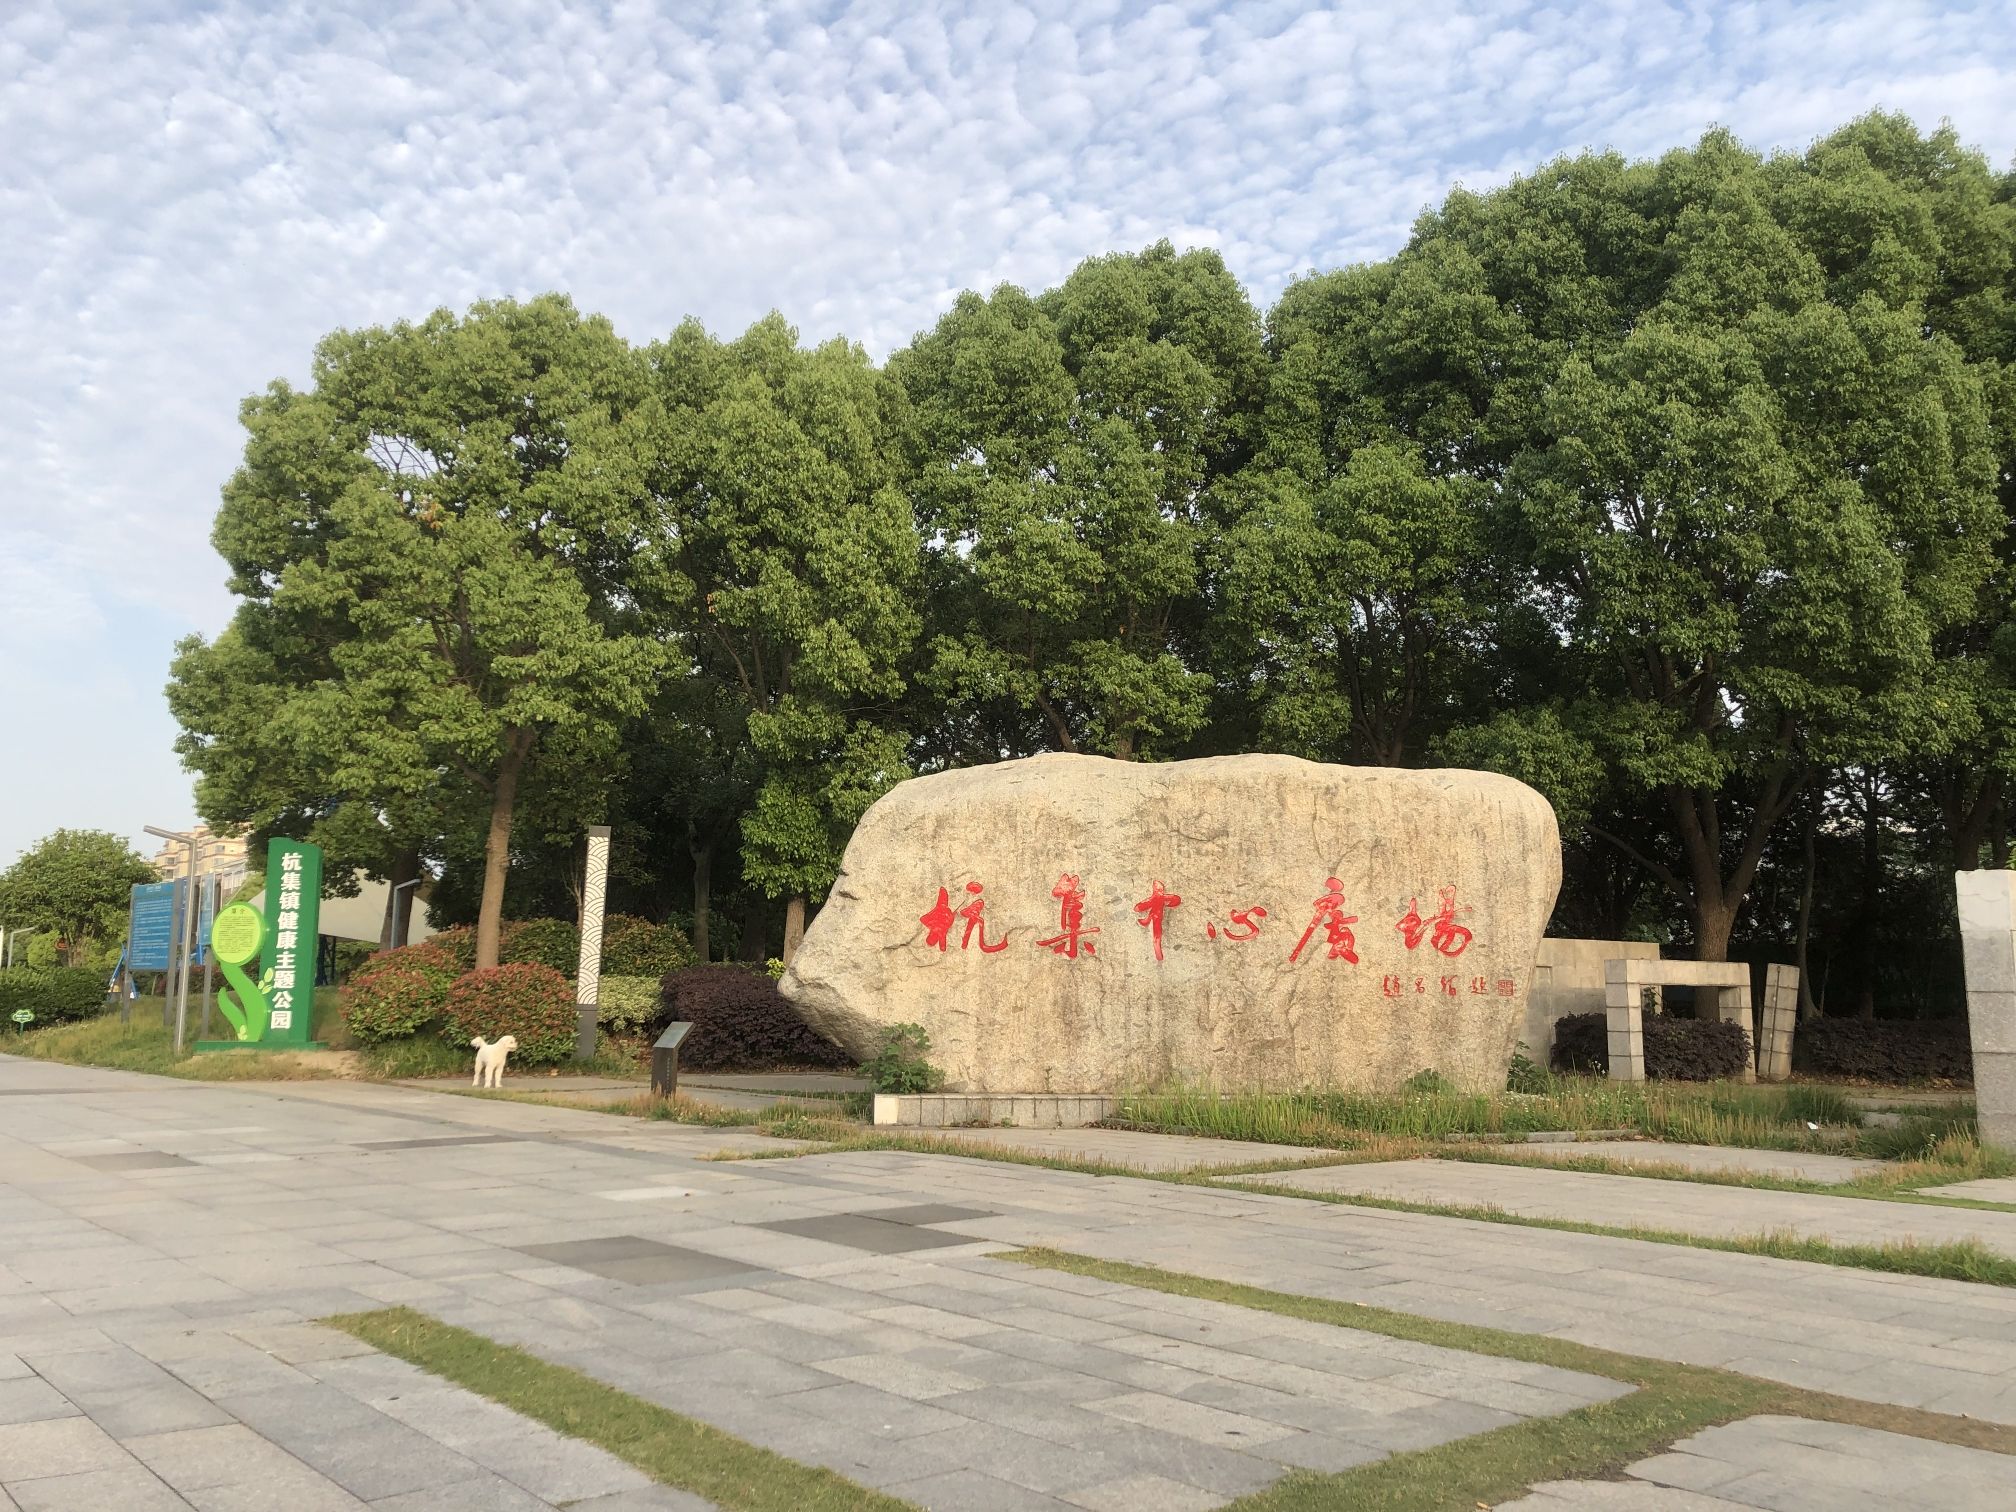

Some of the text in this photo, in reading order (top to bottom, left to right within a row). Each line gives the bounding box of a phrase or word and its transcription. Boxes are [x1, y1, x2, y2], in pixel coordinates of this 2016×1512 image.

[270, 852, 303, 1030] 杭集镇健康主题公园
